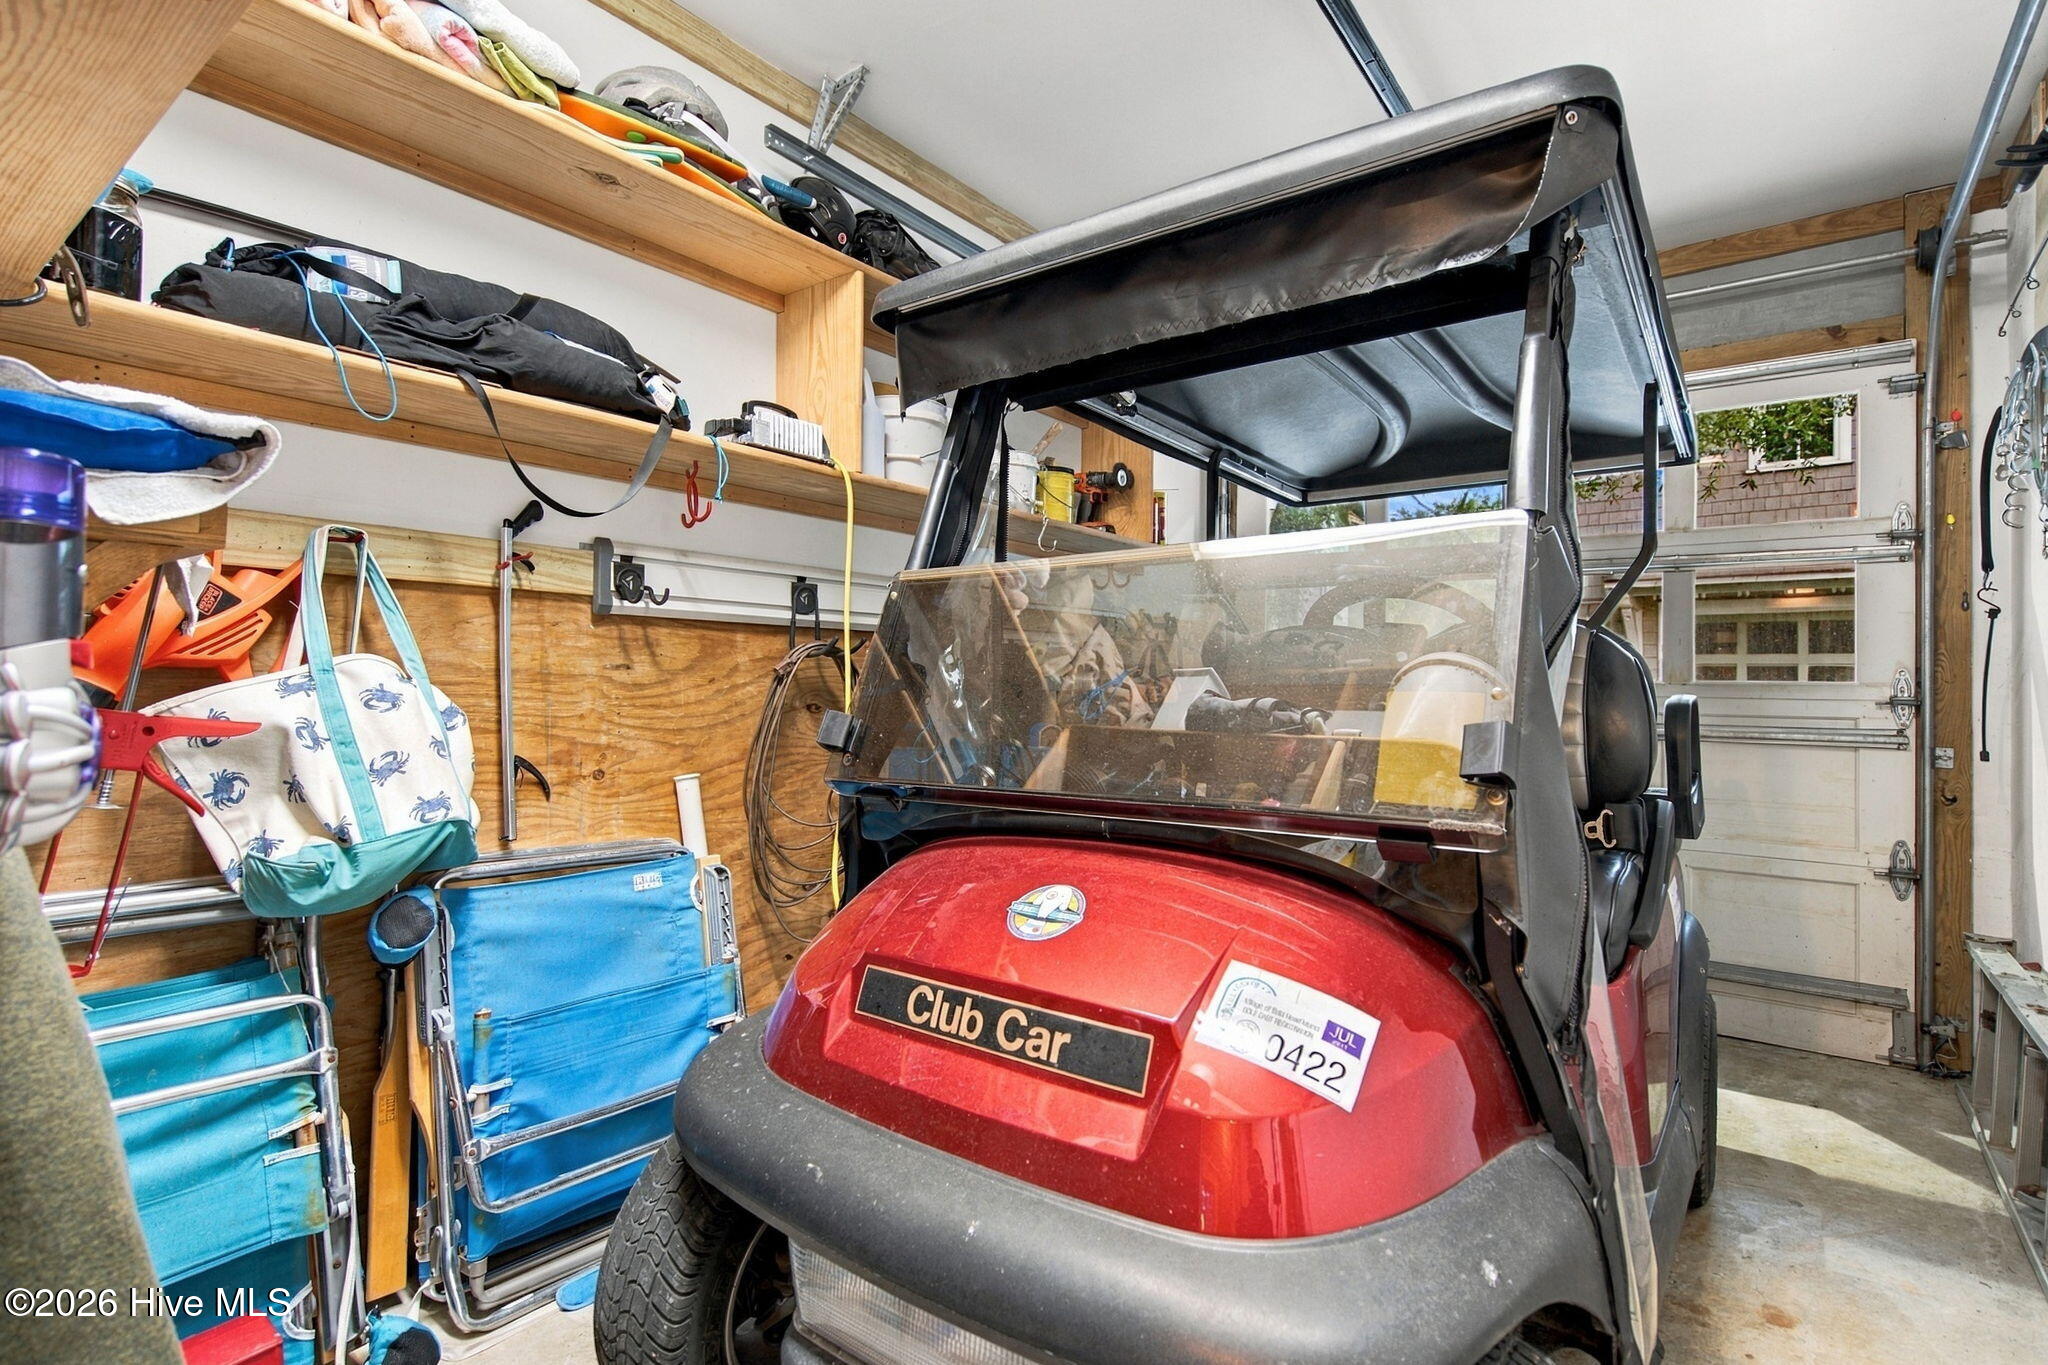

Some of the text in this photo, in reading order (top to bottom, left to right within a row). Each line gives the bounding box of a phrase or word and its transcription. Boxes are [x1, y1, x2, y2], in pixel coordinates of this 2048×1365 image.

[906, 985, 1072, 1064] Club Car
[1329, 1026, 1357, 1049] JUL
[1264, 1033, 1347, 1094] 0422
